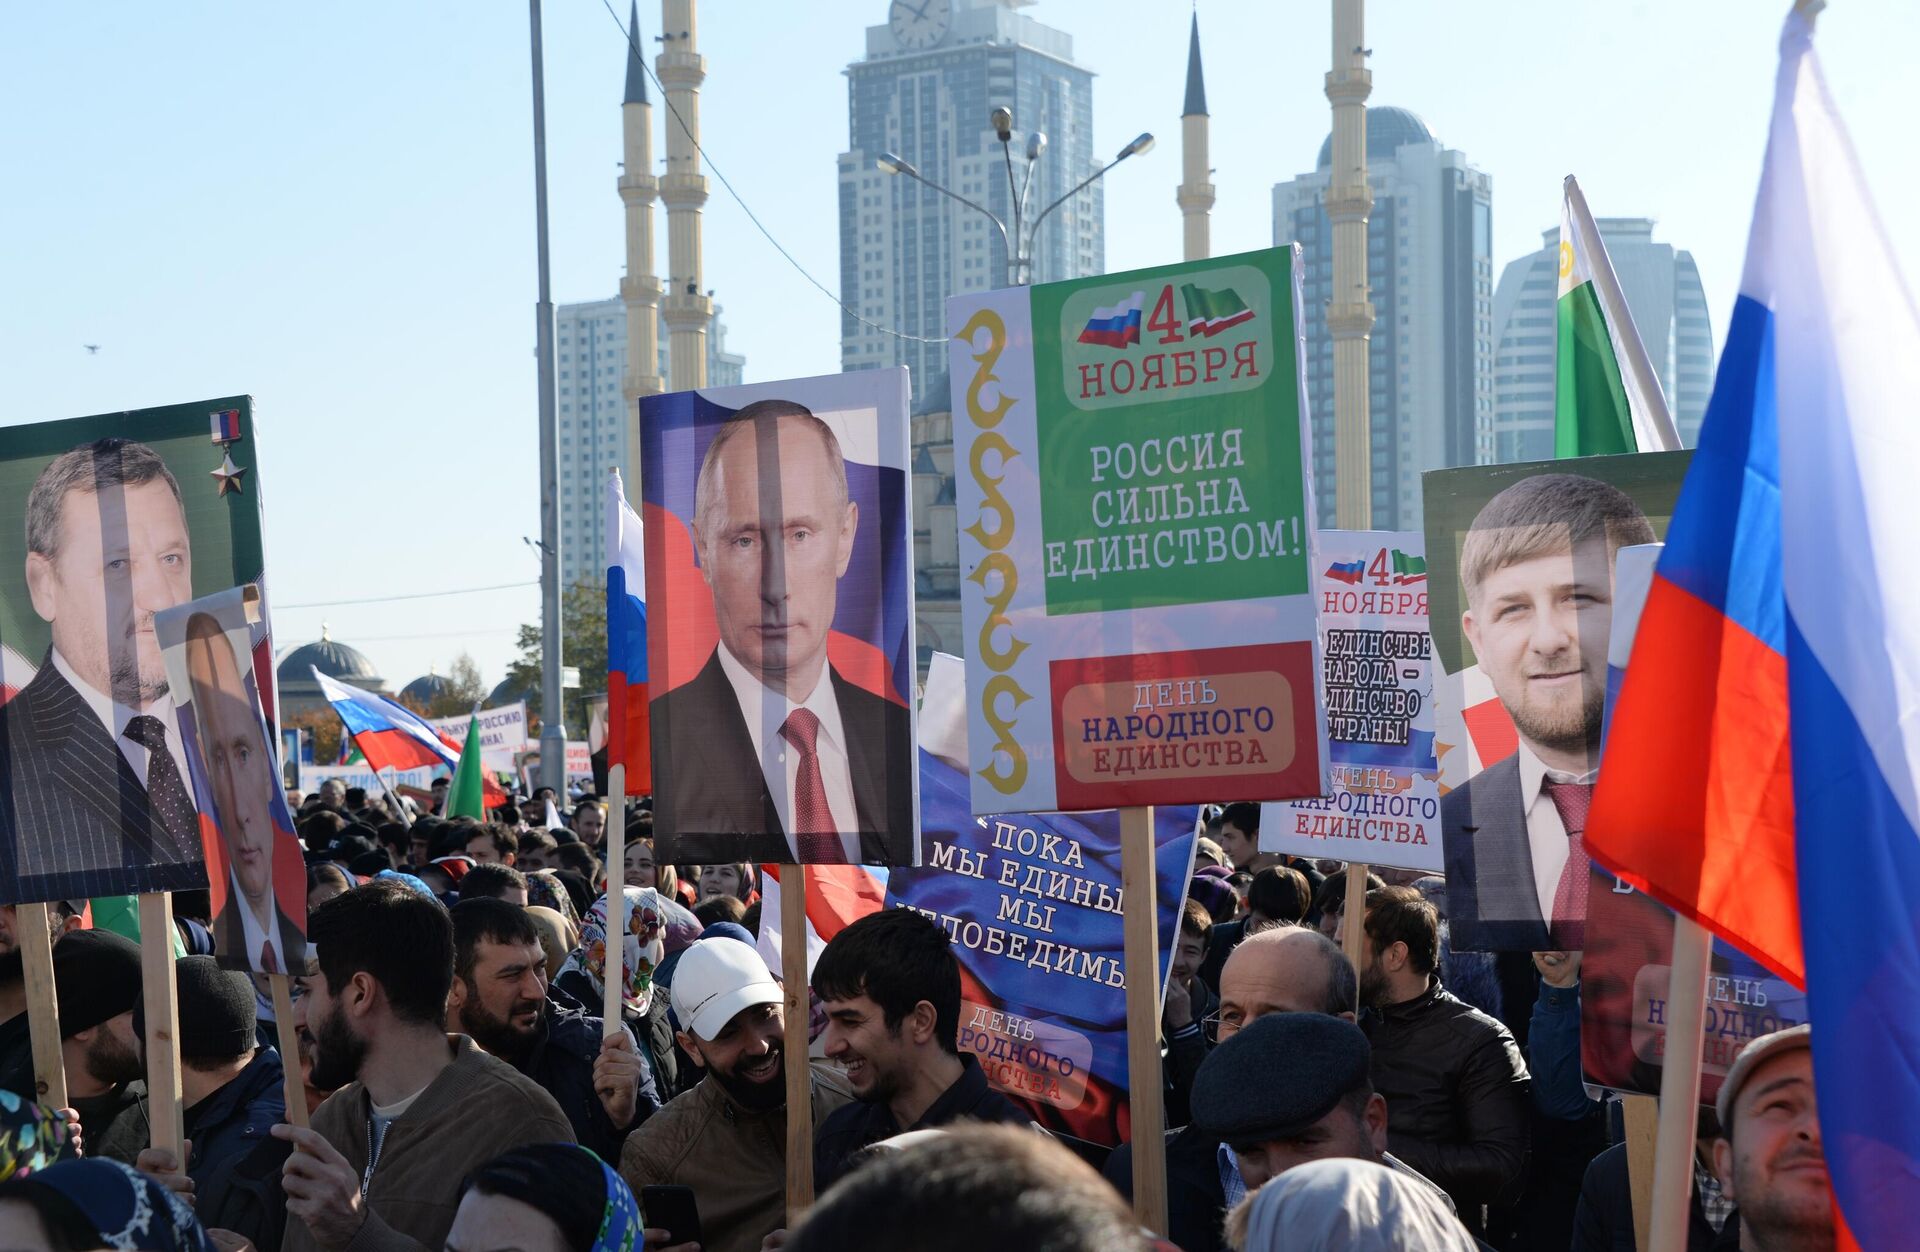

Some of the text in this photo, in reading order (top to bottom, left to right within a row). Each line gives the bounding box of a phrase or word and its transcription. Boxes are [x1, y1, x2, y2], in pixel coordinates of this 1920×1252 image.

[1146, 284, 1185, 345] 4
[1078, 340, 1260, 398] НОЯБРЯ
[1089, 428, 1245, 482] РОССИЯ
[1092, 477, 1250, 528] СИЛЬНА
[1046, 516, 1301, 582] ЕДИНСТВОМ!
[1368, 547, 1390, 587] 4
[1323, 591, 1430, 616] НОЯБРЯ
[1133, 679, 1218, 713] ДЕНЬ
[1326, 688, 1420, 716] ДИНСТВО
[1082, 706, 1275, 743] НАРОДНОГО
[1093, 738, 1268, 776] ЕДИНСТВА
[1332, 765, 1398, 790] ДЕНЬ
[991, 821, 1085, 869] ПОКА
[1295, 813, 1429, 846] ЕДИНСТВА
[929, 841, 1124, 916] МЫ ЕДИНЫ
[996, 894, 1057, 933] МЫ
[1706, 975, 1768, 1008] ЕНЬ
[969, 1006, 1035, 1042] ДЕНЬ
[958, 1026, 1075, 1077] РОДНОГО
[981, 1057, 1062, 1100] НСТВА
